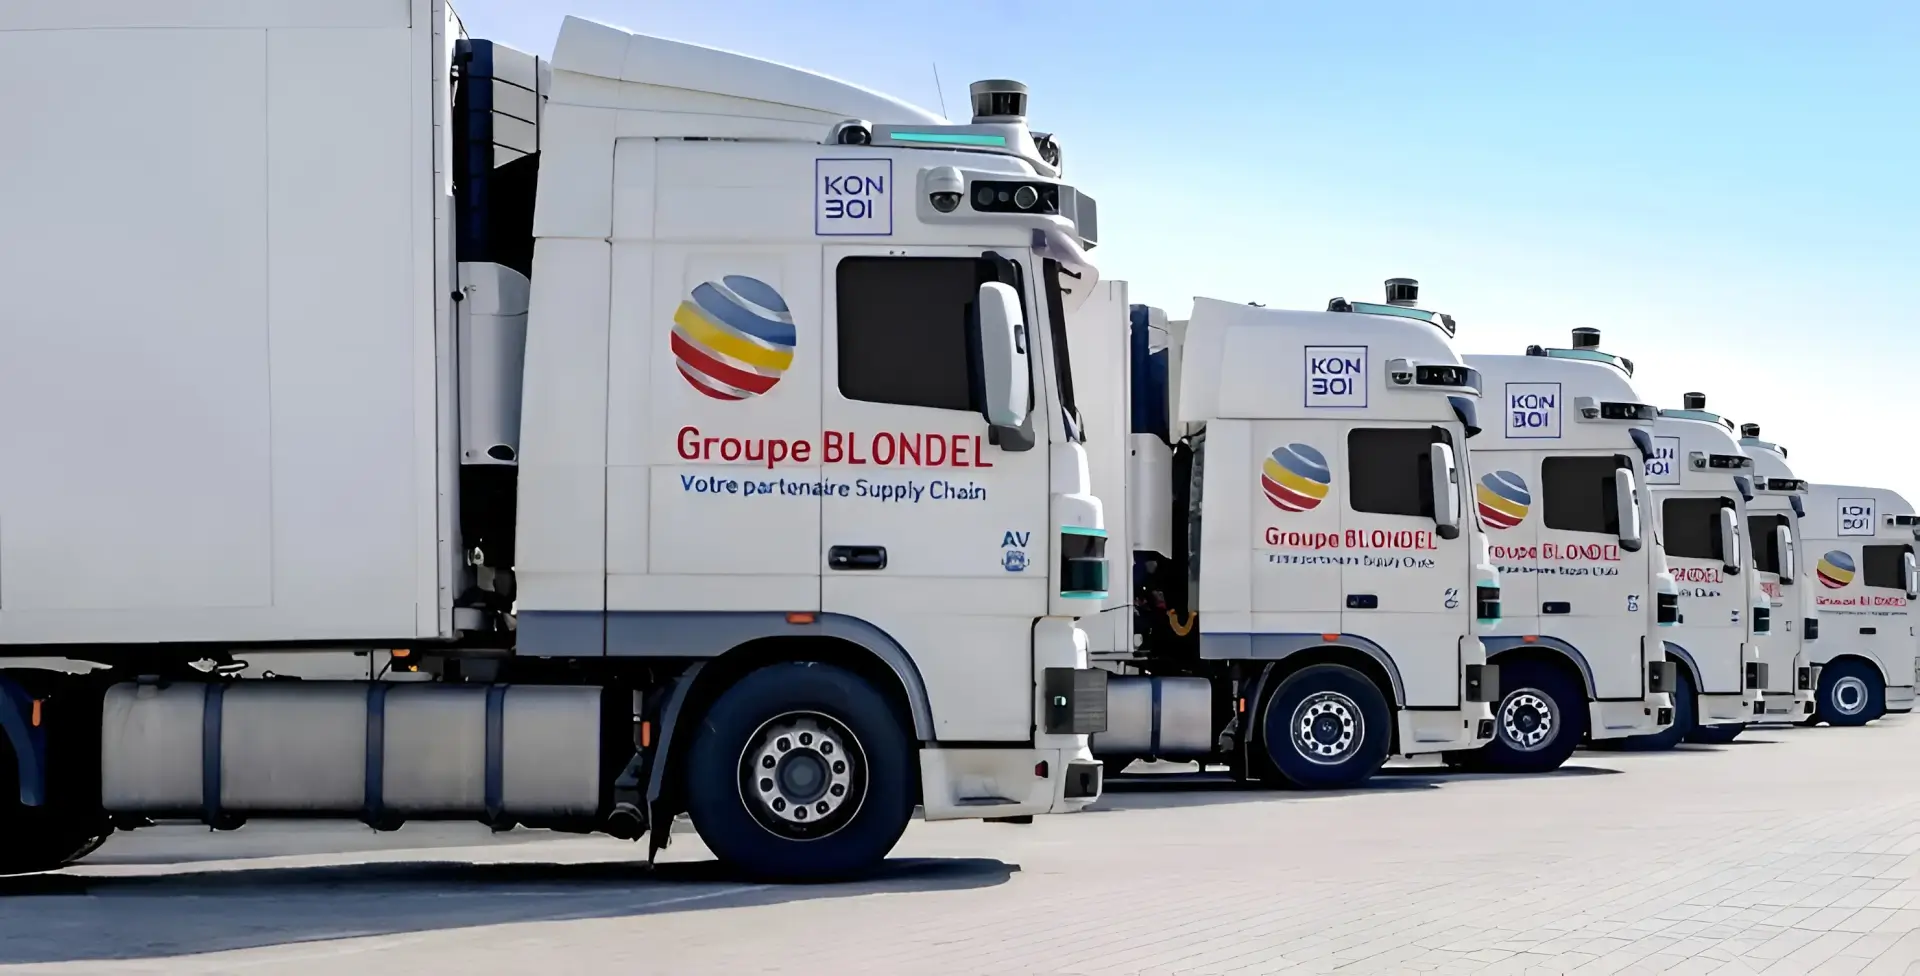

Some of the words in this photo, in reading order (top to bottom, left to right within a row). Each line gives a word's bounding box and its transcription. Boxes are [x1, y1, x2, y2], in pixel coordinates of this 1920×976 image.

[825, 176, 883, 195] KON
[1311, 357, 1361, 375] KON
[677, 426, 812, 469] Groupe
[823, 430, 993, 468] BLONDEL
[680, 474, 739, 494] Votre
[743, 477, 850, 498] partenaire
[855, 478, 925, 504] Supply
[929, 480, 987, 501] Chain
[1000, 530, 1031, 548] AV
